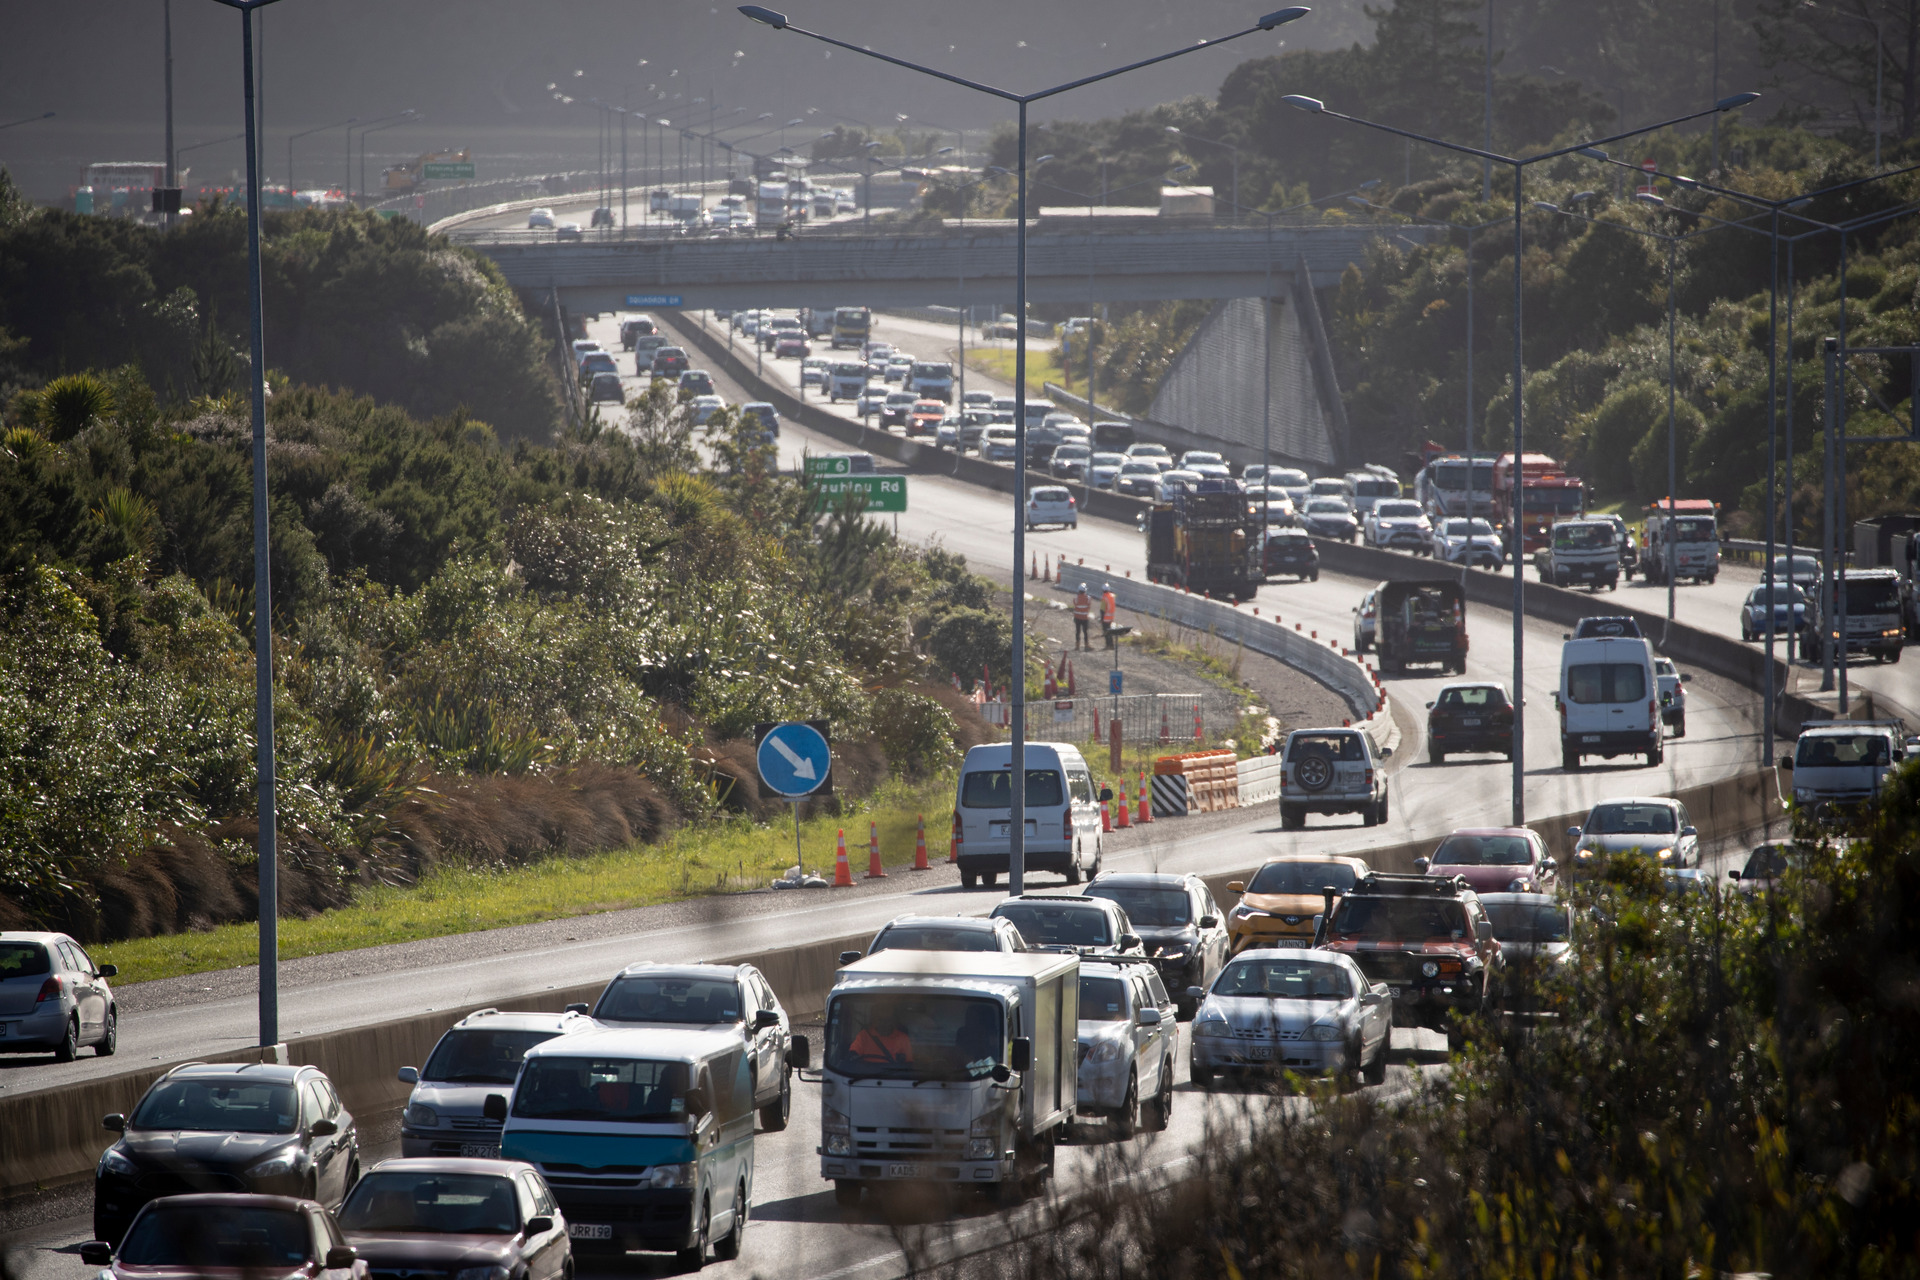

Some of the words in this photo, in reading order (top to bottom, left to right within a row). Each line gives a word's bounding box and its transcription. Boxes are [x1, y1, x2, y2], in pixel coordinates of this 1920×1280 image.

[835, 460, 845, 472] 6
[881, 480, 900, 493] Rd
[461, 1145, 498, 1158] CBK278
